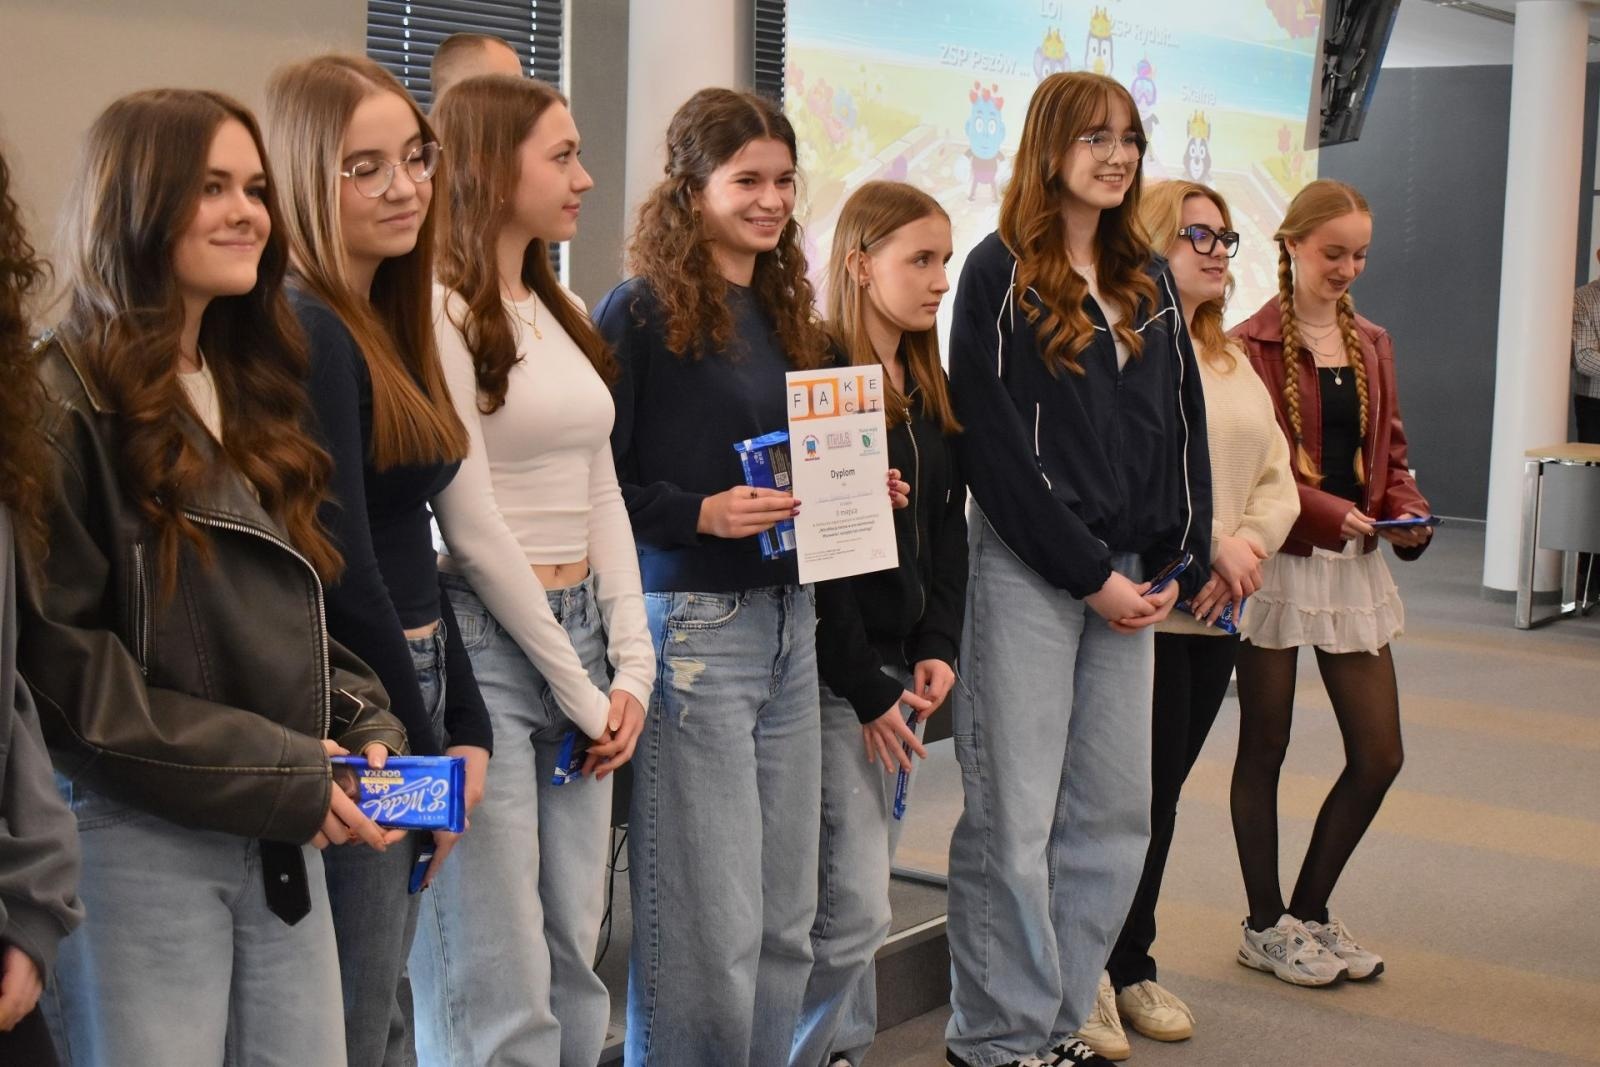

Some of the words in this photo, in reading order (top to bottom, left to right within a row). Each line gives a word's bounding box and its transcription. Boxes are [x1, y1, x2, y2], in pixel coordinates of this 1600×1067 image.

[937, 42, 969, 66] ZSP
[971, 48, 1017, 75] Pszów
[830, 468, 856, 480] Dyplom
[364, 769, 401, 778] GORZKA
[364, 783, 390, 794] 64%
